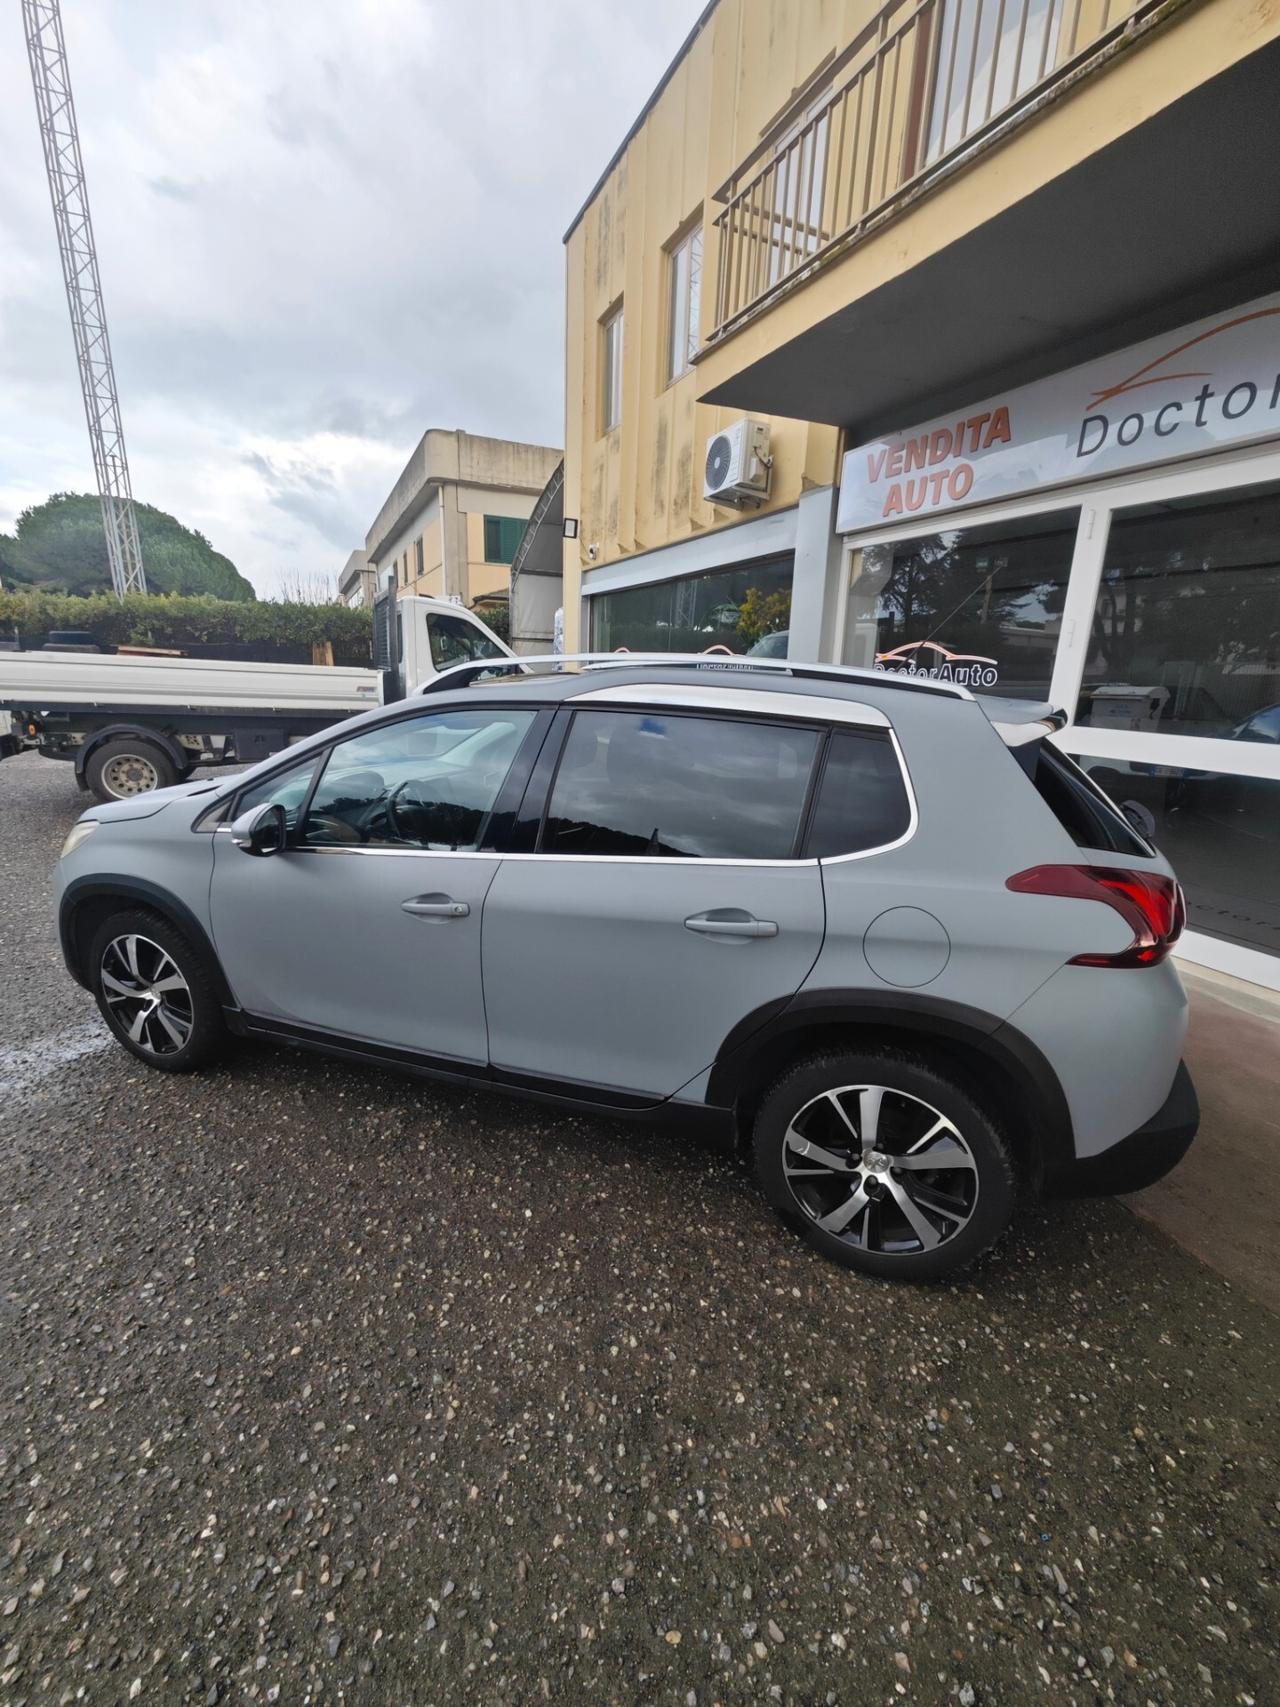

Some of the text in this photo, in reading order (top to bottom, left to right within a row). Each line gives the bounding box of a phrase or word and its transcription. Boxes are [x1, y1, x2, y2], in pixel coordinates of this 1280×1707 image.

[867, 406, 1012, 483] VENDITA
[883, 463, 974, 517] AUTO
[874, 663, 998, 687] torAuto
